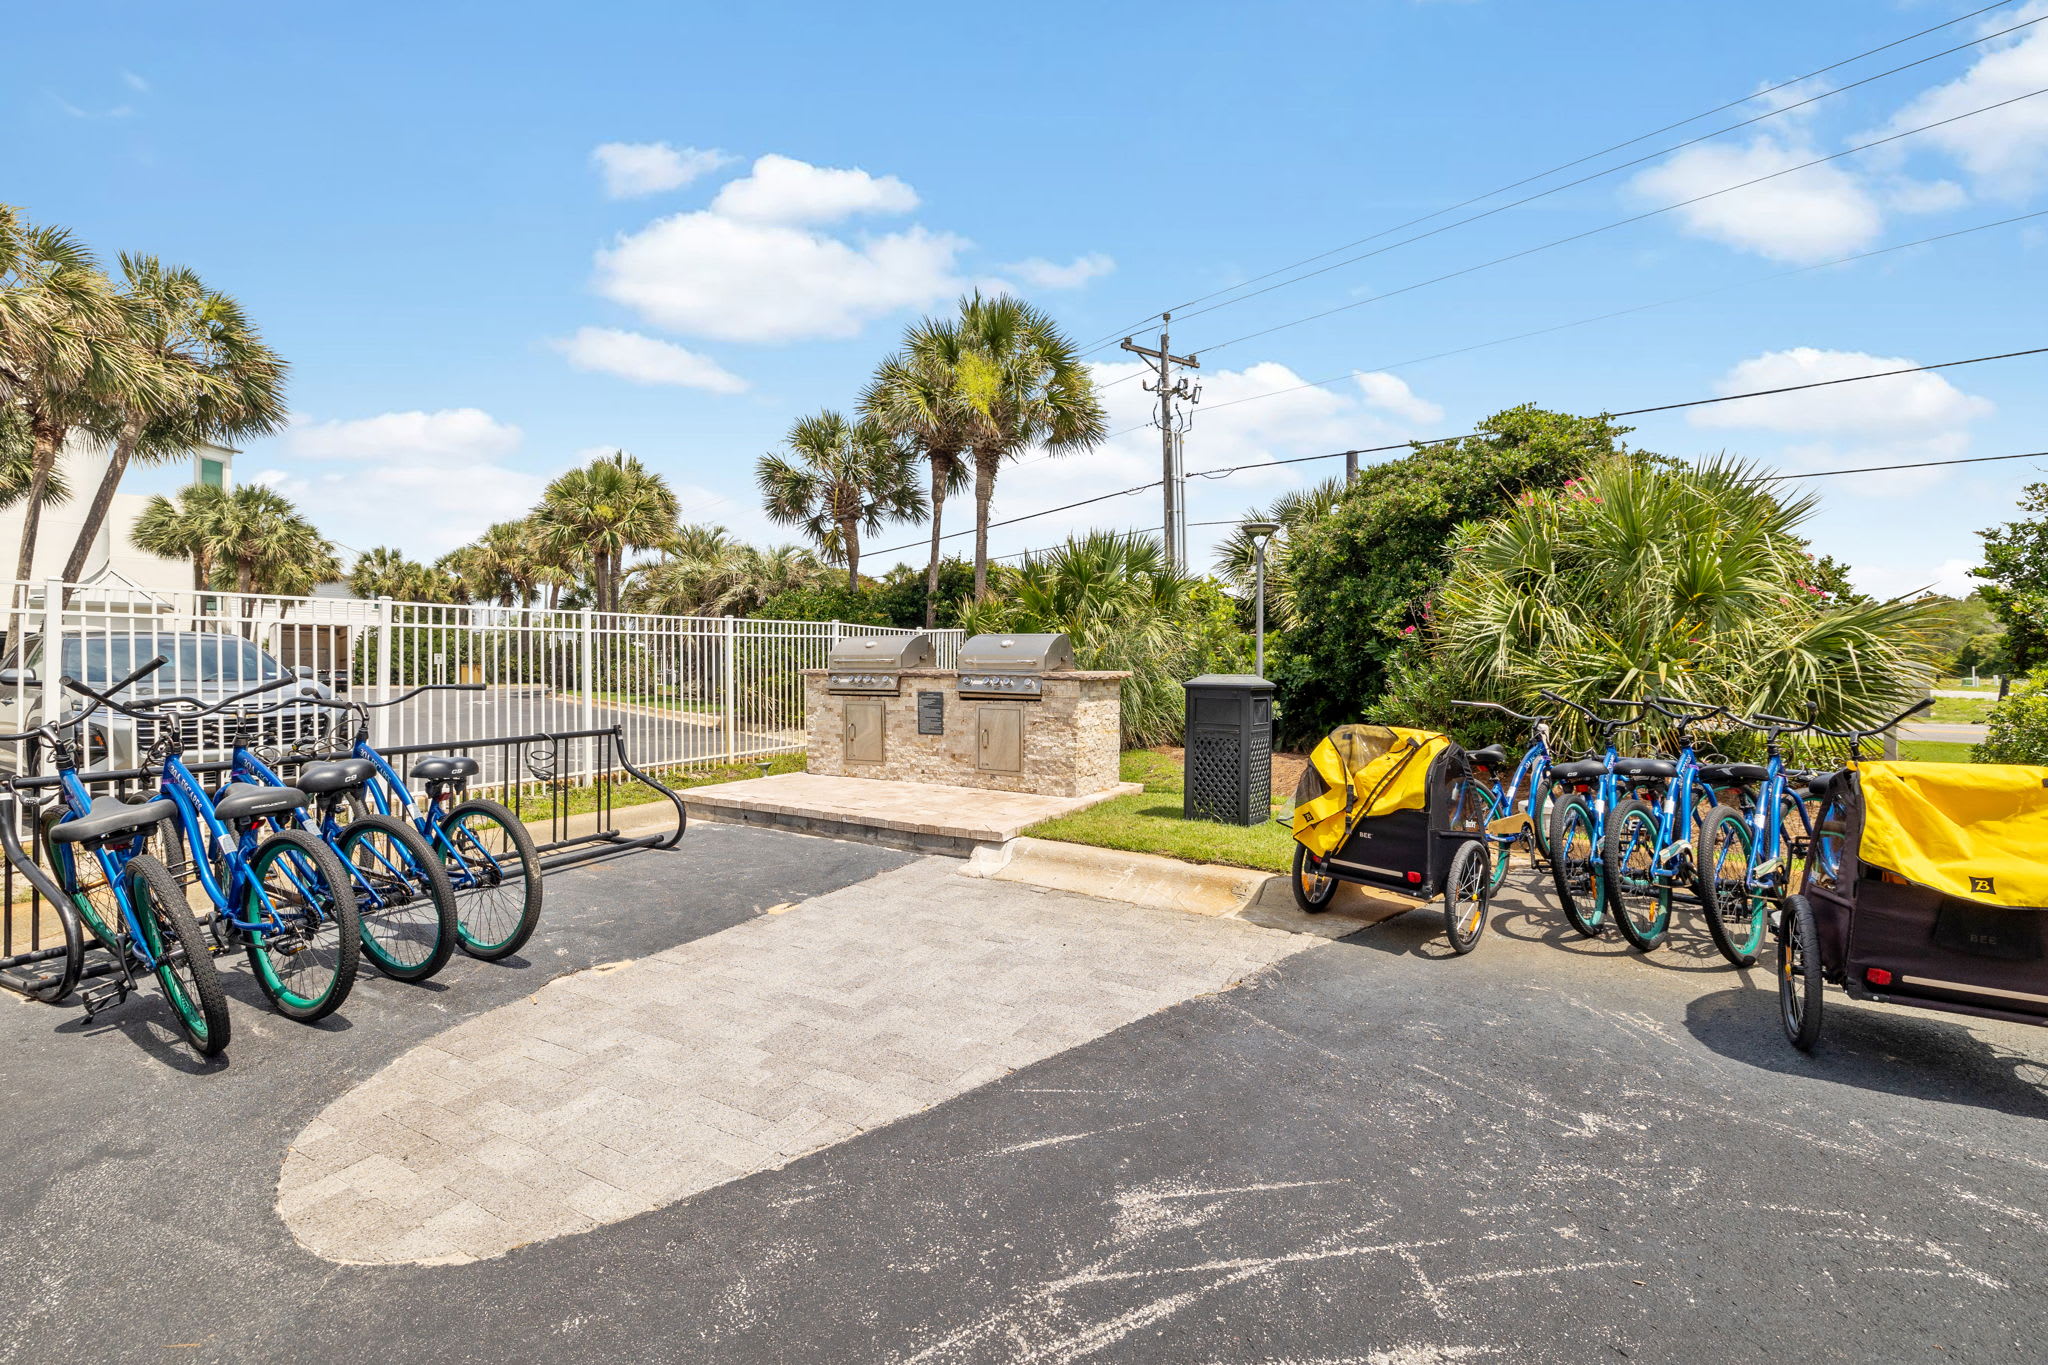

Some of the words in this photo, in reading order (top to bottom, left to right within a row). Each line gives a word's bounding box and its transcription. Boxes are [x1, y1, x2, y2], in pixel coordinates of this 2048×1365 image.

[168, 764, 181, 783] 30A
[180, 778, 203, 811] ESCAPES
[1359, 831, 1372, 839] BEE
[1969, 934, 1997, 944] BEE
